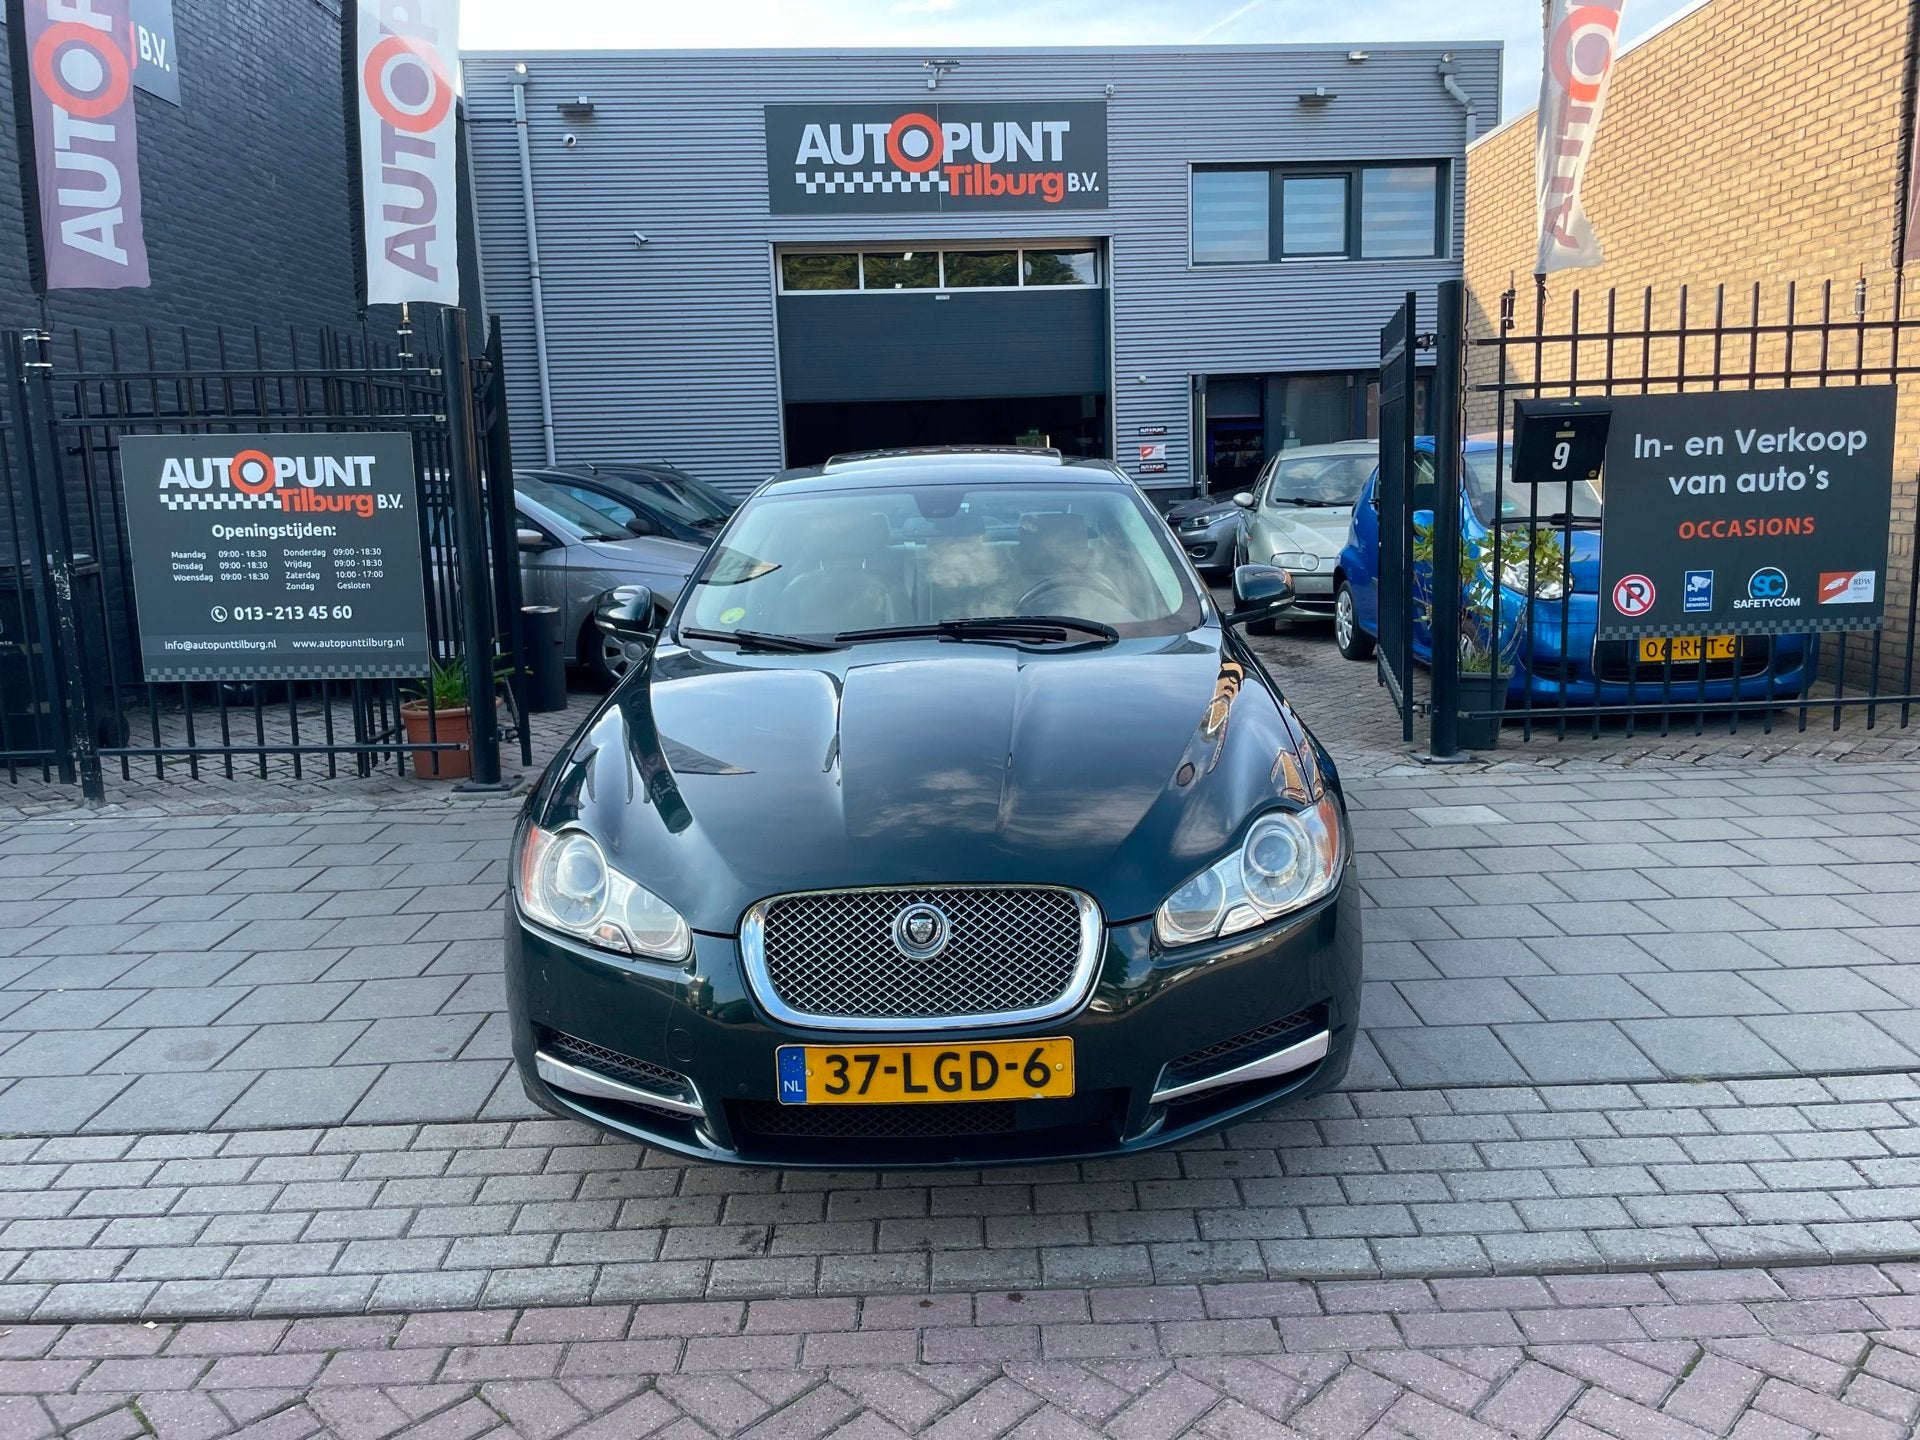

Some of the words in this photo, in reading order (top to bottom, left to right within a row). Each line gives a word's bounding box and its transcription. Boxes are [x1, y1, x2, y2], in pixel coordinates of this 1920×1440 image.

[138, 24, 171, 73] B.V.
[795, 113, 1070, 173] AUTOPUNT
[944, 164, 1064, 203] Tilburg
[1067, 172, 1099, 192] B.V.
[1633, 433, 1673, 459] In-
[1685, 435, 1723, 457] en
[1735, 426, 1868, 457] Verkoop
[1552, 441, 1571, 471] 9
[159, 449, 376, 495] AUTOPUNT
[1668, 474, 1726, 496] van
[1736, 464, 1830, 493] auto's
[277, 488, 374, 517] Tilburg
[377, 493, 403, 509] B.V.
[211, 522, 337, 540] Openingstijden:
[1678, 516, 1816, 541] OCCASIONS
[171, 550, 207, 560] Maandag
[218, 550, 240, 558] 09:00
[246, 550, 267, 558] 18:30
[283, 548, 326, 558] Donderdag
[333, 548, 354, 556] 09:00
[361, 548, 382, 556] 18:30
[172, 562, 204, 571] Dinsdag
[219, 561, 241, 569] 09:00
[247, 561, 268, 569] 18:30
[284, 560, 312, 569] Vrijdag
[334, 559, 356, 567] 09:00
[362, 559, 383, 567] 18:30
[173, 573, 214, 583] Woensdag
[220, 573, 242, 581] 09:00
[285, 571, 321, 580] Zaterdag
[363, 570, 384, 578] 17:00
[286, 582, 315, 592] Zondag
[337, 581, 371, 590] Gesloten
[1733, 597, 1800, 610] SAFETYCOM
[308, 605, 329, 620] 45
[332, 605, 353, 620] 60
[164, 639, 277, 651] info@autopunttilburg.nl
[292, 637, 405, 649] www.autopunttilburg.nl
[824, 1047, 1051, 1096] 37-LGD-6
[783, 1079, 804, 1093] NL
